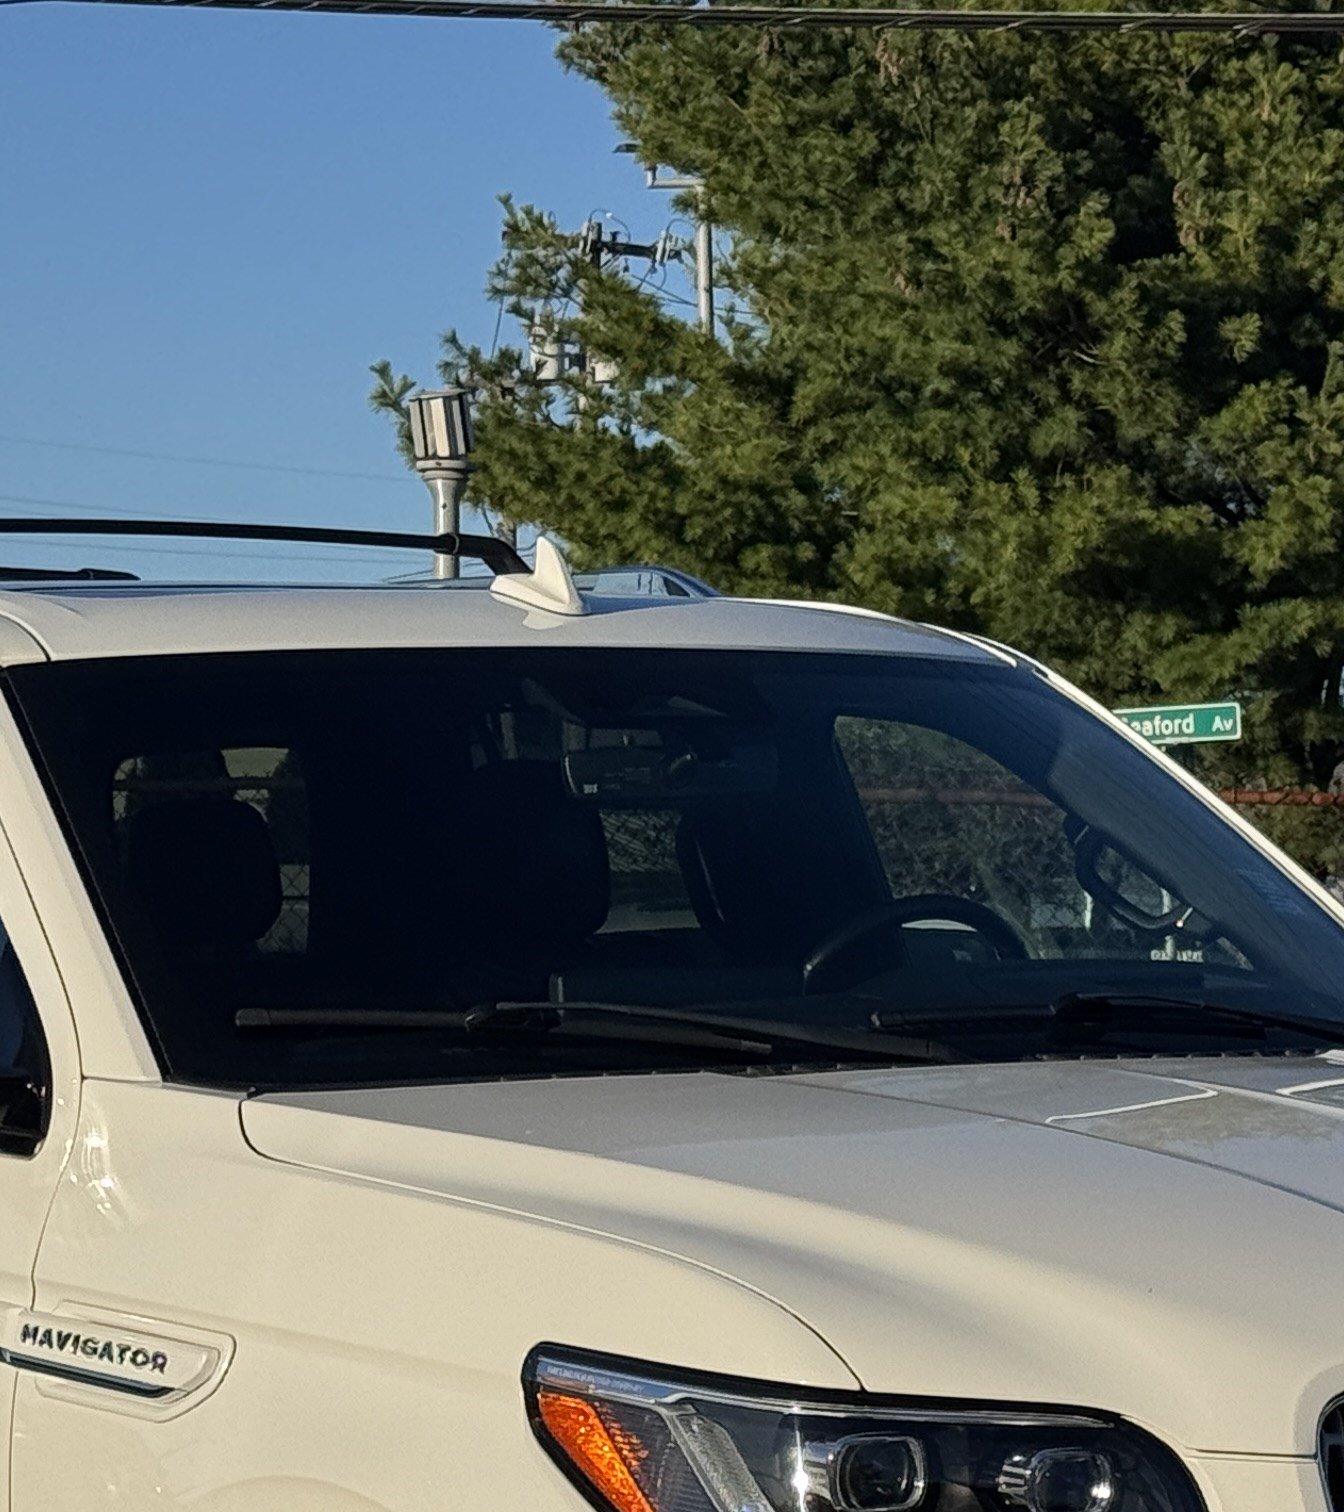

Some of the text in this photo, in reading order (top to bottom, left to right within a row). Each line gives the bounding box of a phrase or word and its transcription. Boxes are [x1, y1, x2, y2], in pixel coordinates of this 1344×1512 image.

[1121, 713, 1234, 737] eaford Av
[19, 1322, 169, 1374] NAVIGATOR
